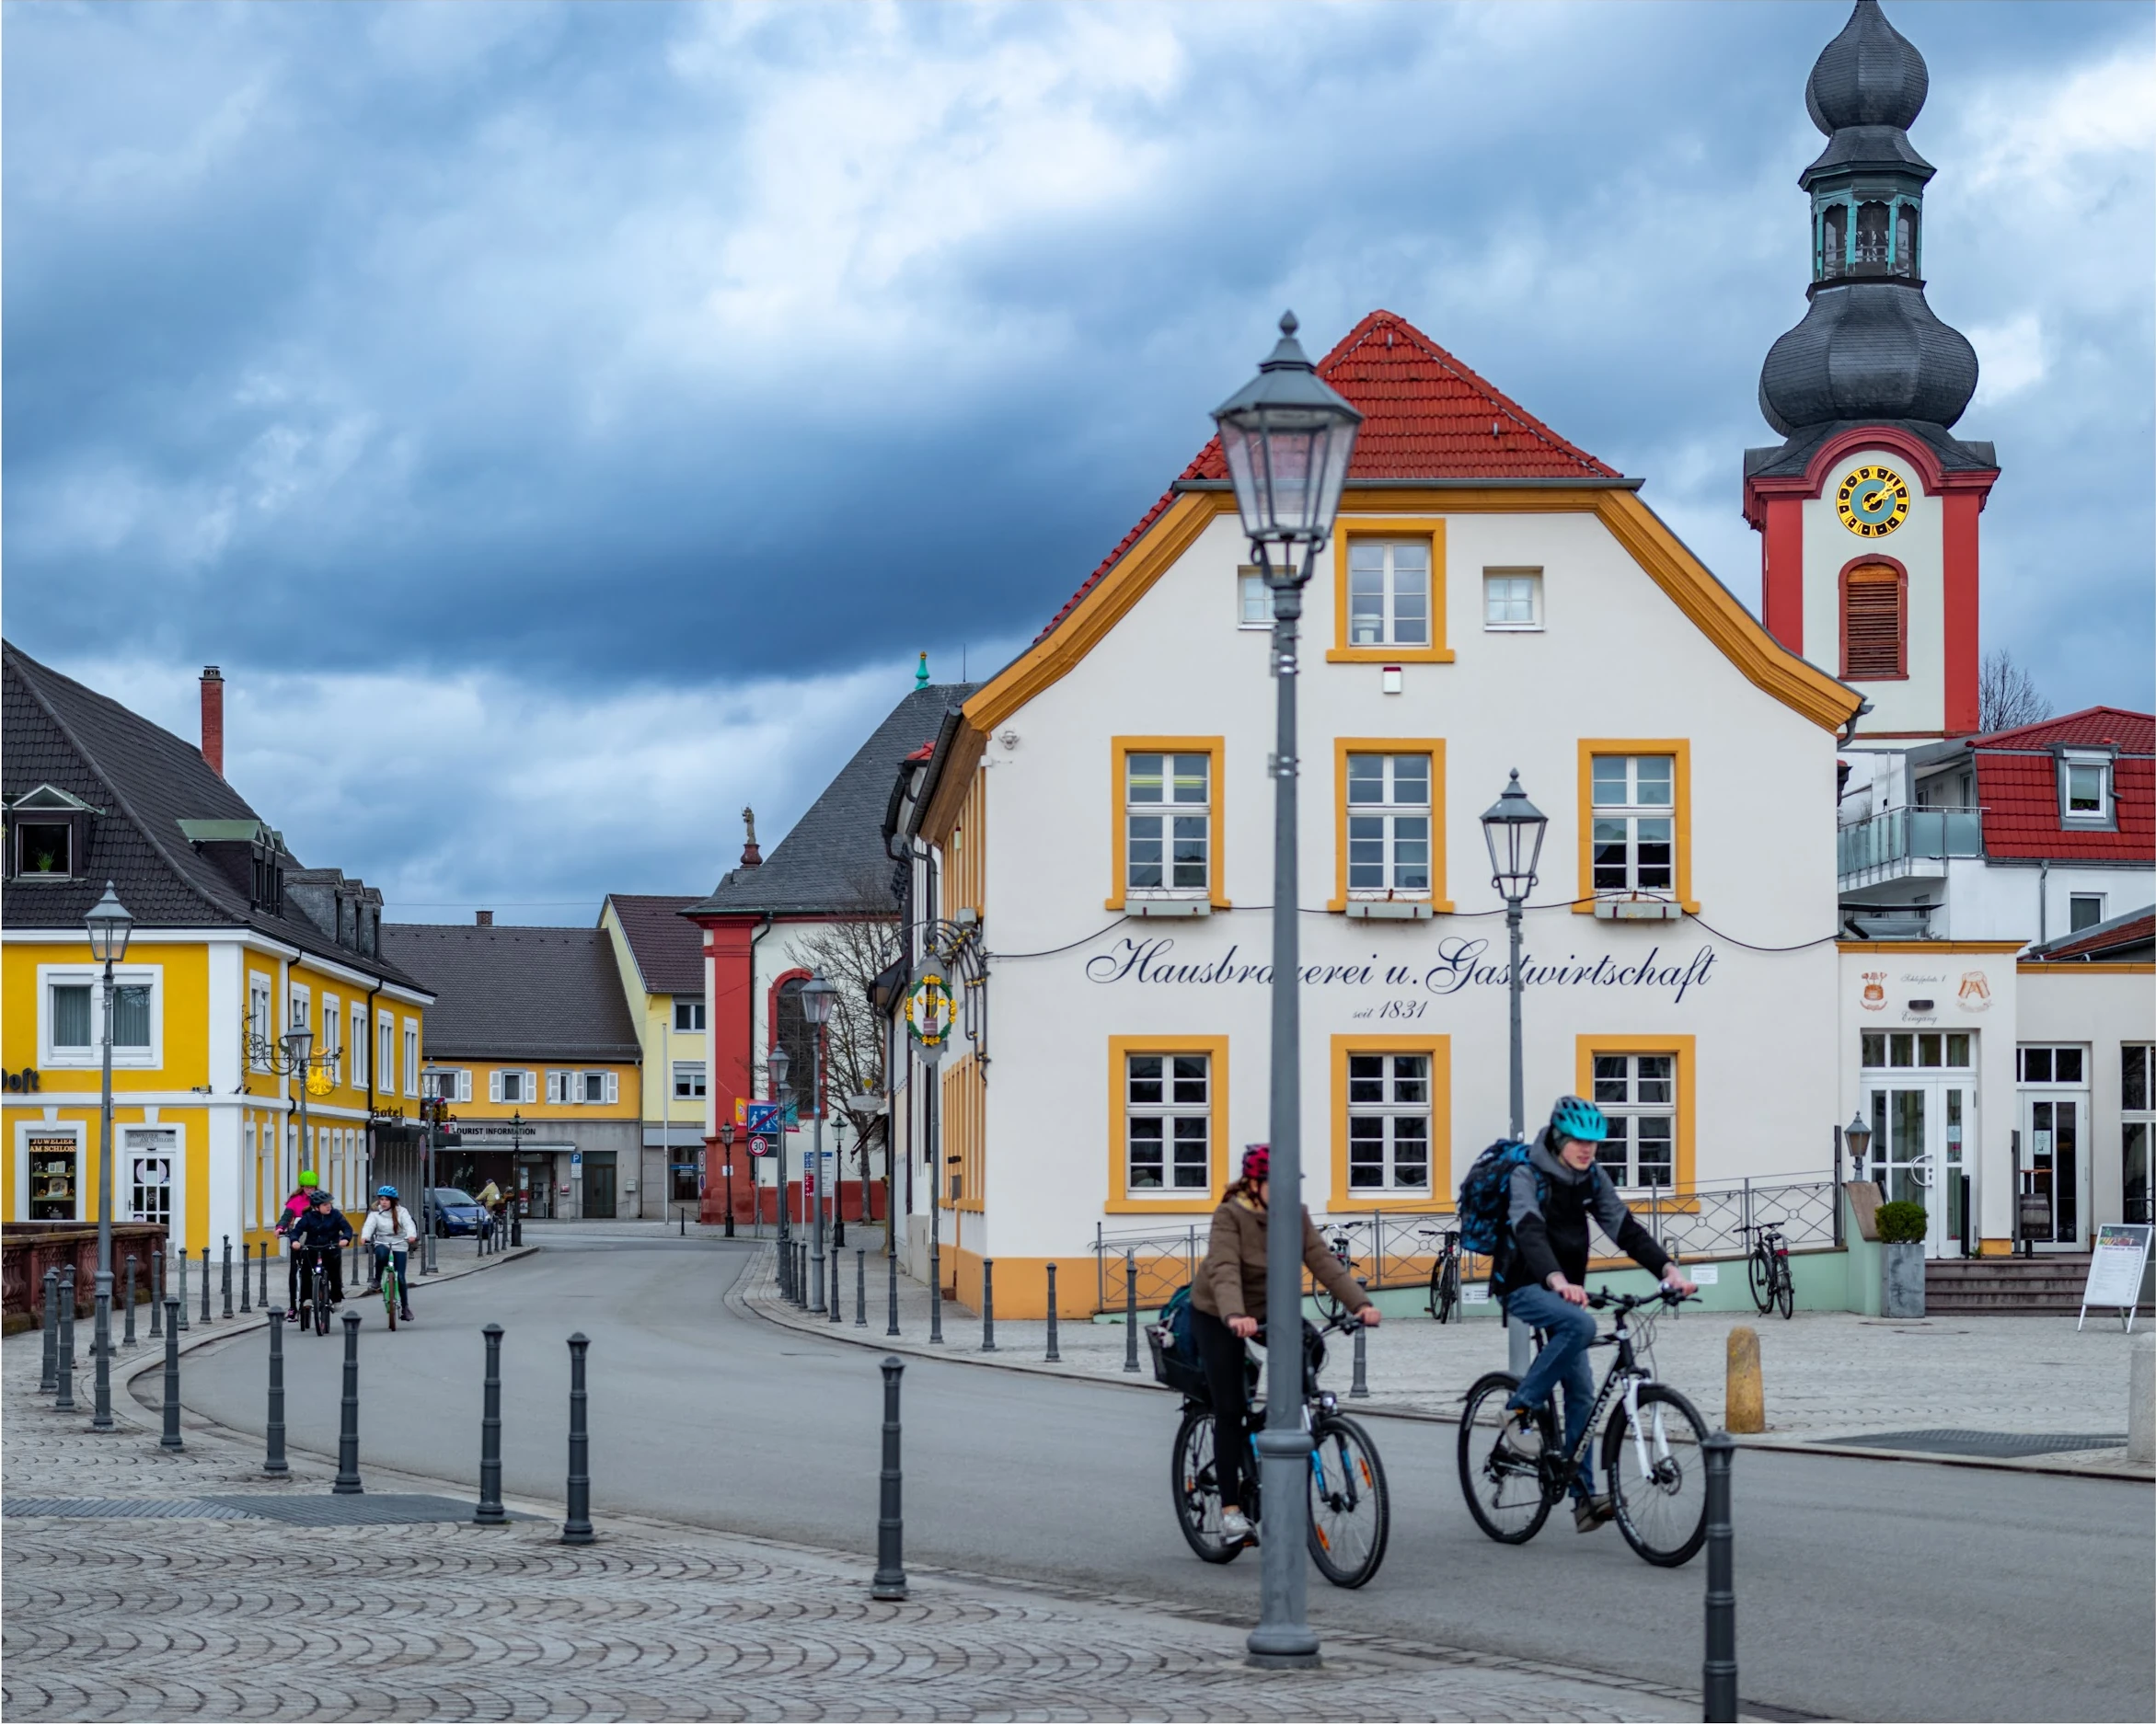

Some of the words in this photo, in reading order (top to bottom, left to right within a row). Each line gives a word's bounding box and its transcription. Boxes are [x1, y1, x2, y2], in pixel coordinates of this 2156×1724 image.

[1086, 937, 1374, 984] Hausbraerei
[1385, 965, 1418, 984] u.
[1353, 1008, 1374, 1018] seit
[1379, 1000, 1428, 1018] 1831
[1901, 1011, 1938, 1025] Eingang
[753, 1142, 765, 1151] 30
